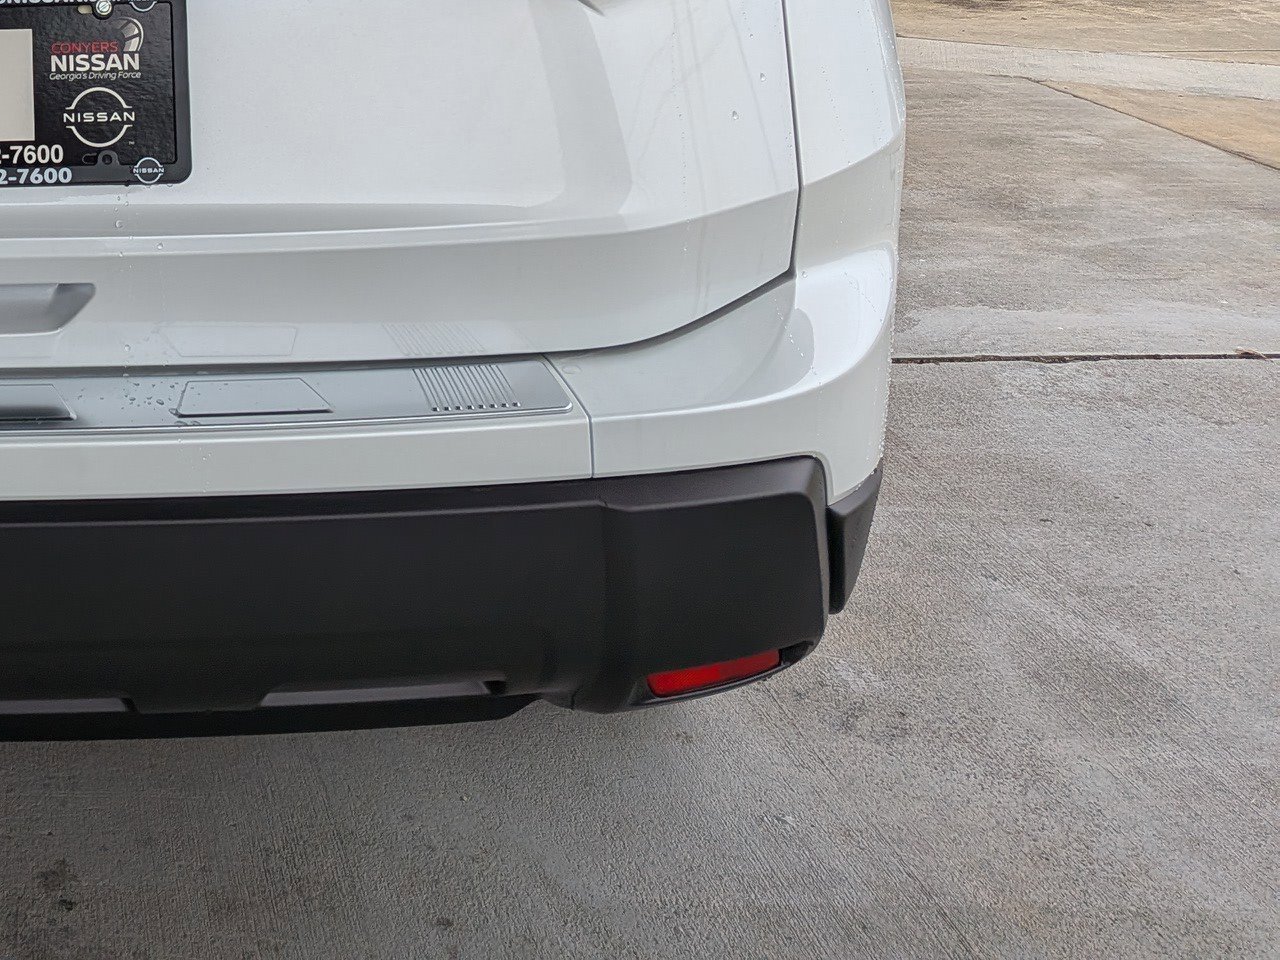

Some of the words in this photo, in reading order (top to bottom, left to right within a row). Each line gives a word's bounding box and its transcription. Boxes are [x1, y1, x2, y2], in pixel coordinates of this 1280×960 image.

[51, 41, 119, 54] CONYERS
[50, 53, 141, 73] NISSAN
[49, 72, 88, 82] Georgia's
[88, 72, 117, 81] Driving
[117, 71, 142, 79] Force
[63, 111, 136, 123] NISSAN
